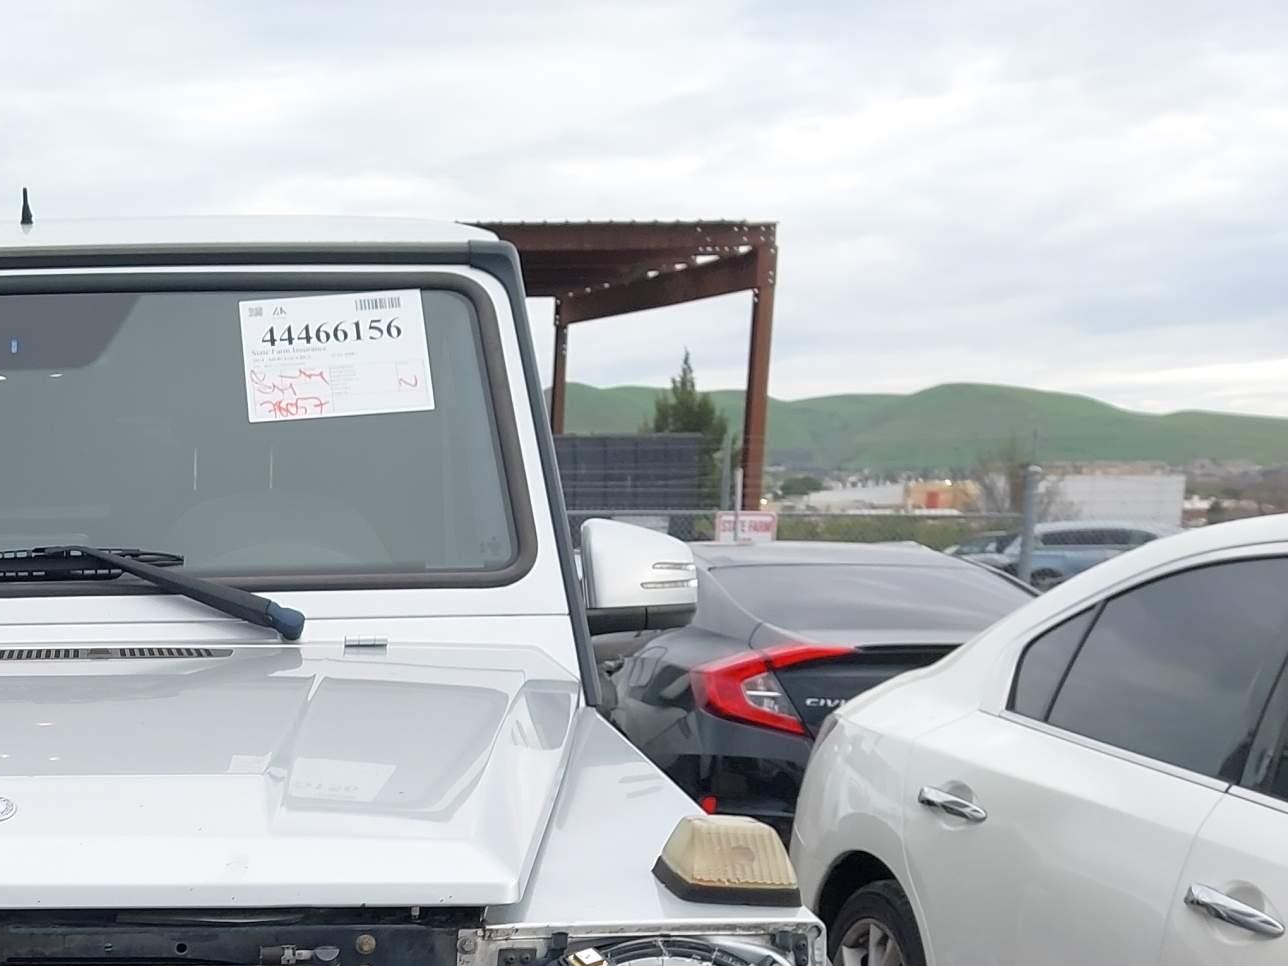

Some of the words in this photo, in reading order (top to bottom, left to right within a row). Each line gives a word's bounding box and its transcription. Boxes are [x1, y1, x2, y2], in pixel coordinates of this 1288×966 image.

[262, 317, 402, 347] 44466156
[720, 520, 746, 532] STTE
[805, 698, 846, 707] CIVI
